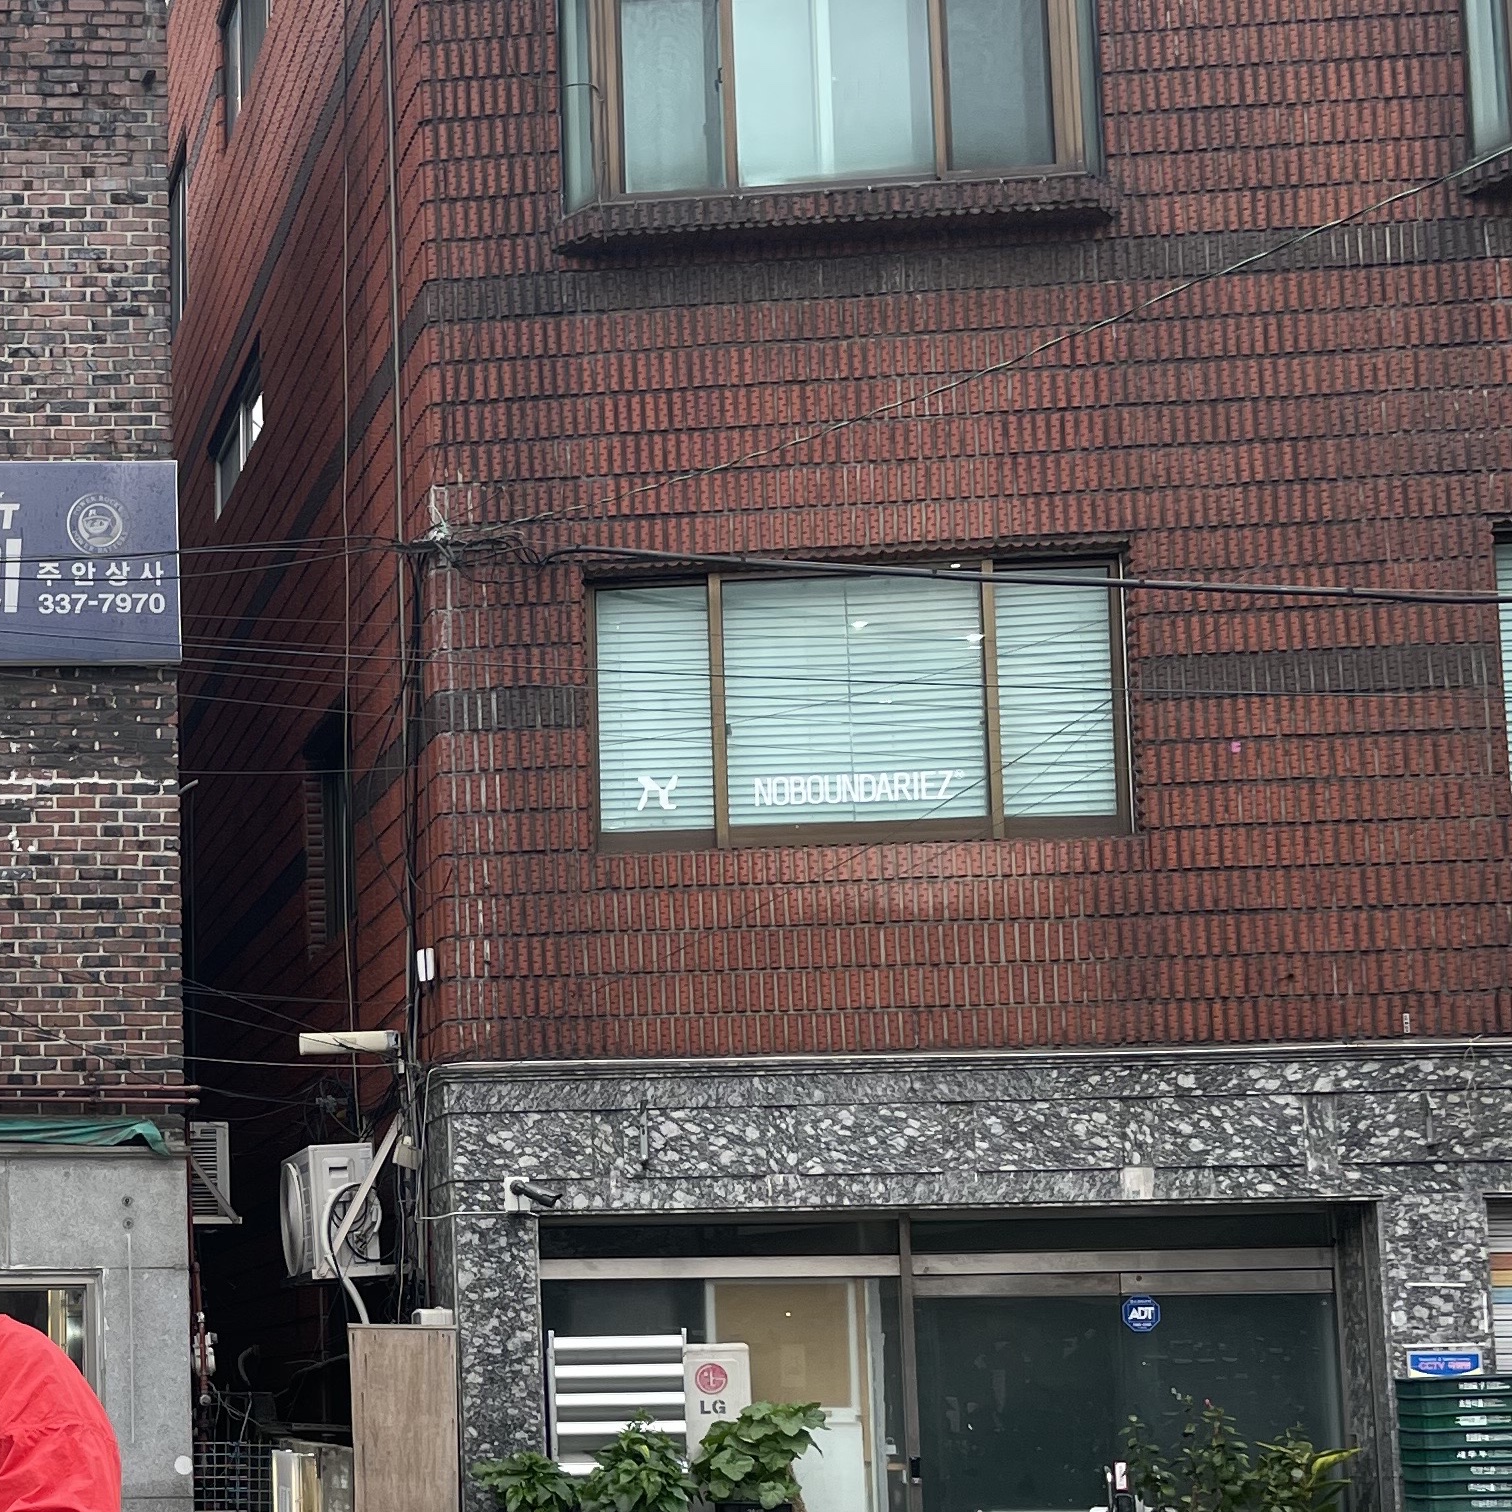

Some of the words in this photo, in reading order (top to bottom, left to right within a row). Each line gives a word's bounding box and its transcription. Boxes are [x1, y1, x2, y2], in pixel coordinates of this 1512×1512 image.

[37, 593, 166, 615] 337-7970
[753, 770, 956, 807] NOBOUNDARIEZ
[1127, 1306, 1155, 1320] ADT
[699, 1399, 726, 1415] LG
